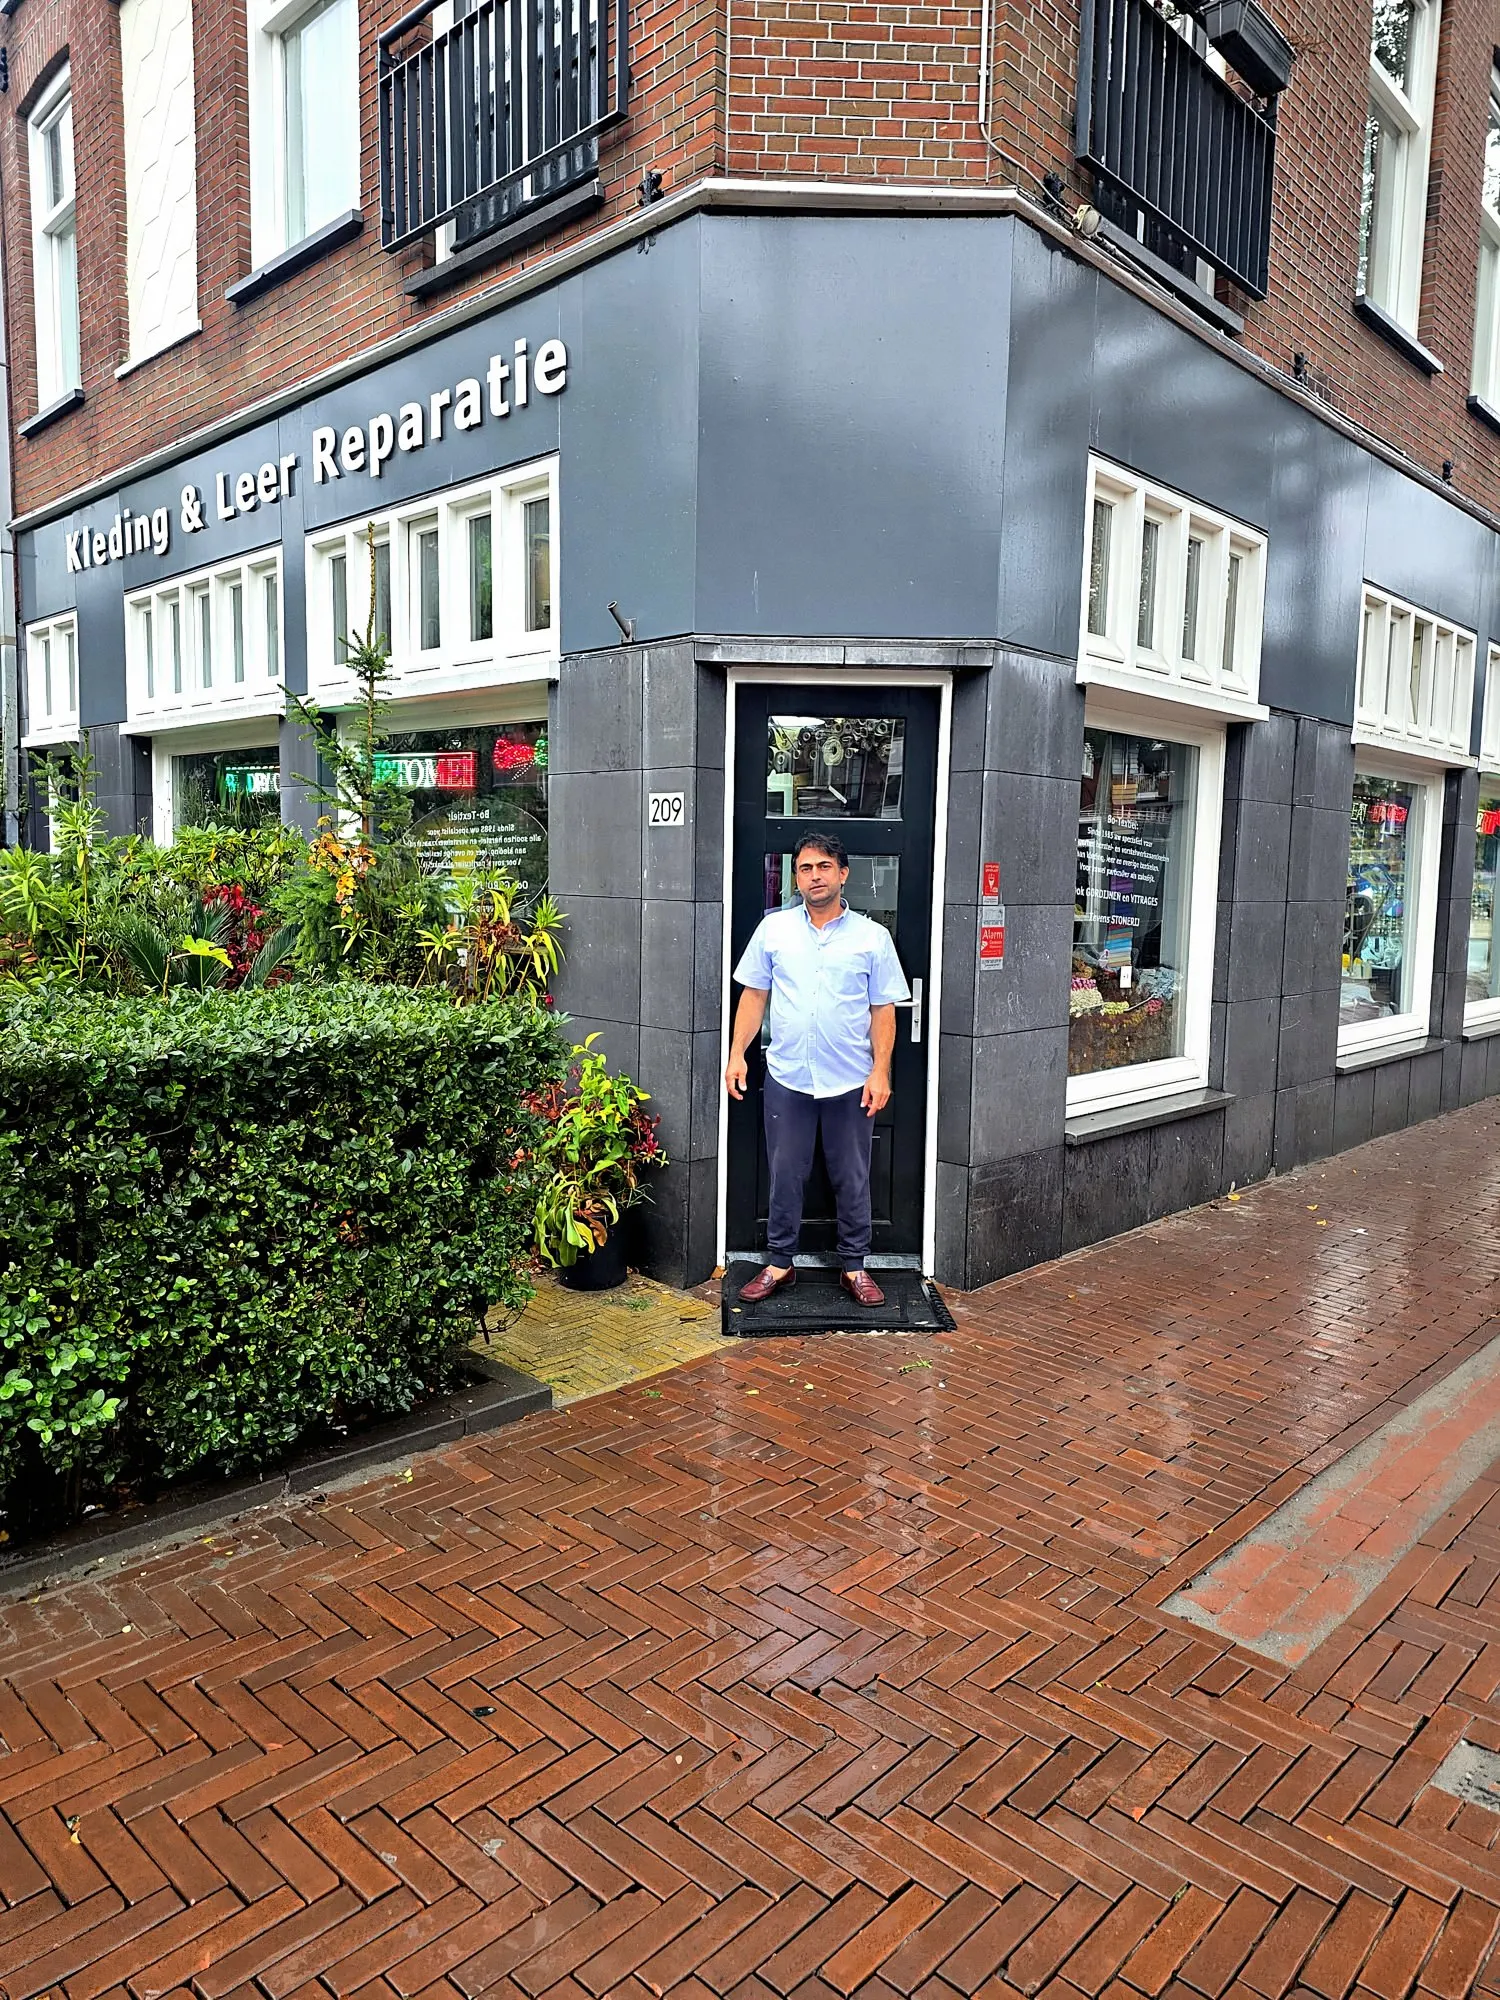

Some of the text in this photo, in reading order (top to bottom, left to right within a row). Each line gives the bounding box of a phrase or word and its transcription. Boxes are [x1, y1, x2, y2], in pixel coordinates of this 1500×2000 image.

[65, 337, 568, 574] Kleding & Leer Reparatie
[651, 797, 682, 823] 209
[1075, 887, 1085, 896] ok
[1122, 893, 1130, 901] en
[1130, 894, 1158, 906] VITRAGES
[982, 929, 1003, 940] Alarm
